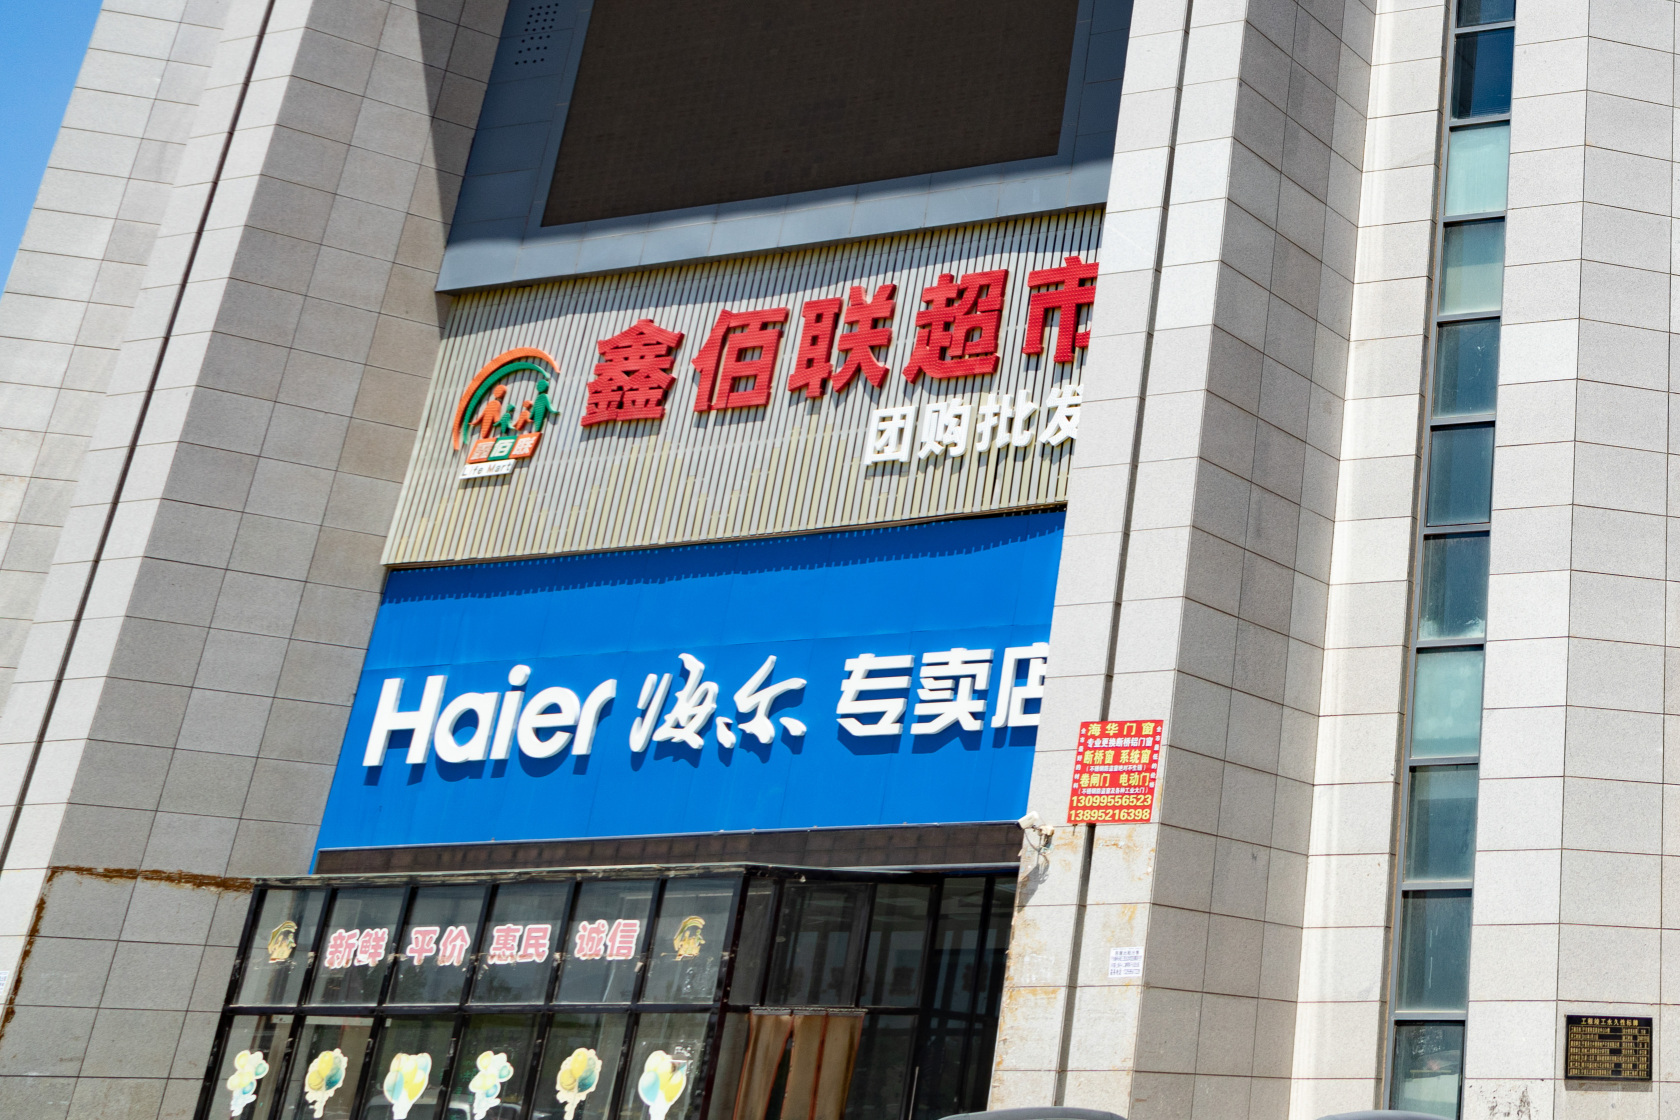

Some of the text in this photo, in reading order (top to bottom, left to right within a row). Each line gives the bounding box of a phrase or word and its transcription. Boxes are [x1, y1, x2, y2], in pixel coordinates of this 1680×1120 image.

[581, 255, 1099, 427] 鑫佰联超市
[864, 384, 1084, 465] 团购批发
[362, 642, 1049, 767] Haier 海尔 专卖店
[1087, 722, 1155, 736] 海华门窗
[1083, 749, 1151, 764] 断桥窗 系统窗
[1080, 772, 1150, 787] 卷闸门 电动门
[1071, 795, 1152, 807] 13099556523
[1069, 809, 1150, 821] 13895216398
[325, 919, 640, 969] 新鲜 平价 惠民 诚信
